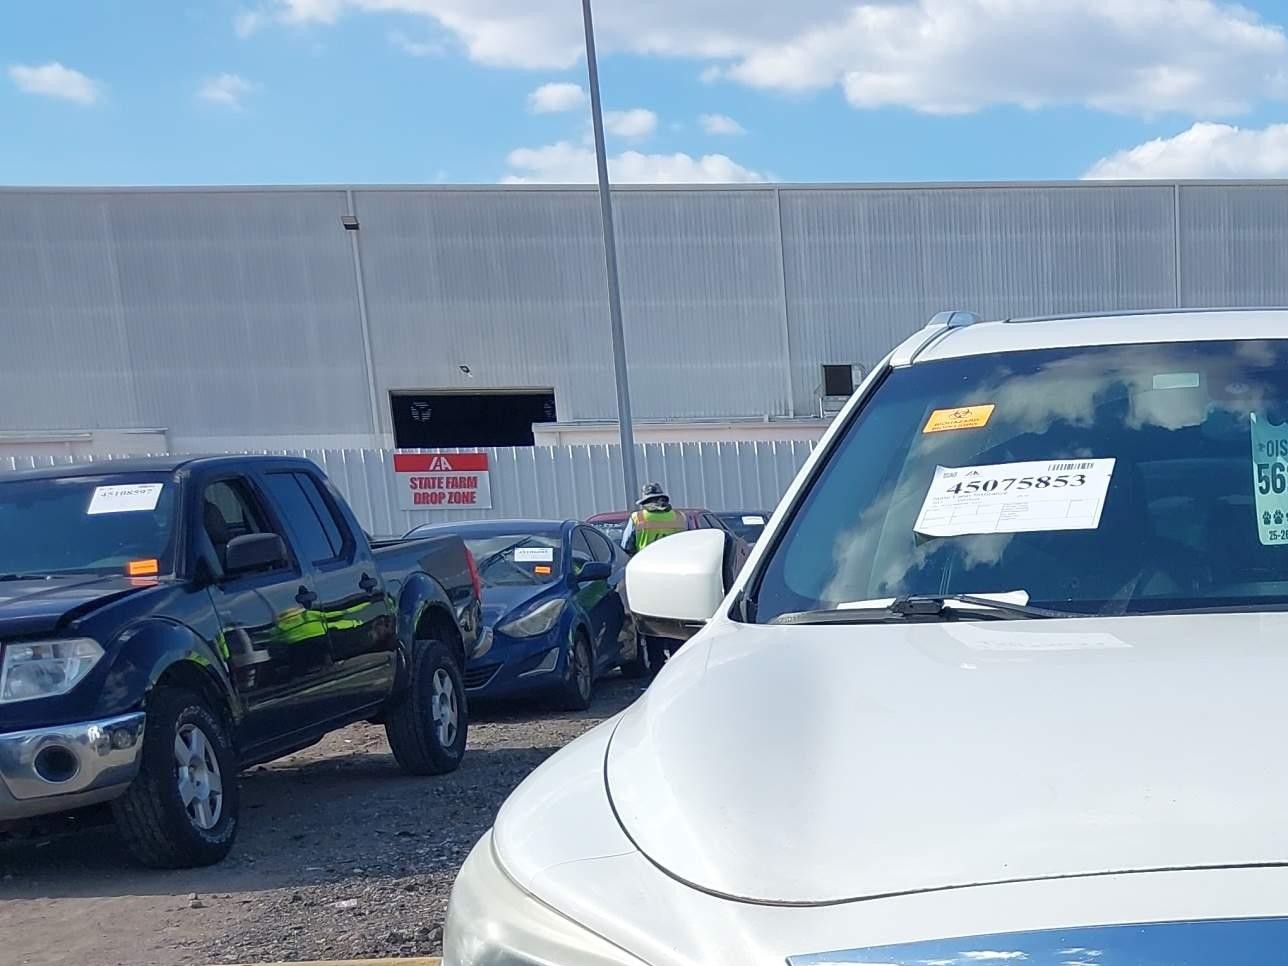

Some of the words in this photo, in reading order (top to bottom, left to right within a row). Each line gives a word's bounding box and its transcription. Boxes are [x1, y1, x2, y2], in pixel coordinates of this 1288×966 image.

[1266, 440, 1288, 457] OIS
[409, 477, 444, 490] STATE
[446, 476, 478, 489] FARM
[946, 474, 1087, 494] 45075853
[413, 492, 447, 505] DROP
[447, 492, 477, 504] ZONE
